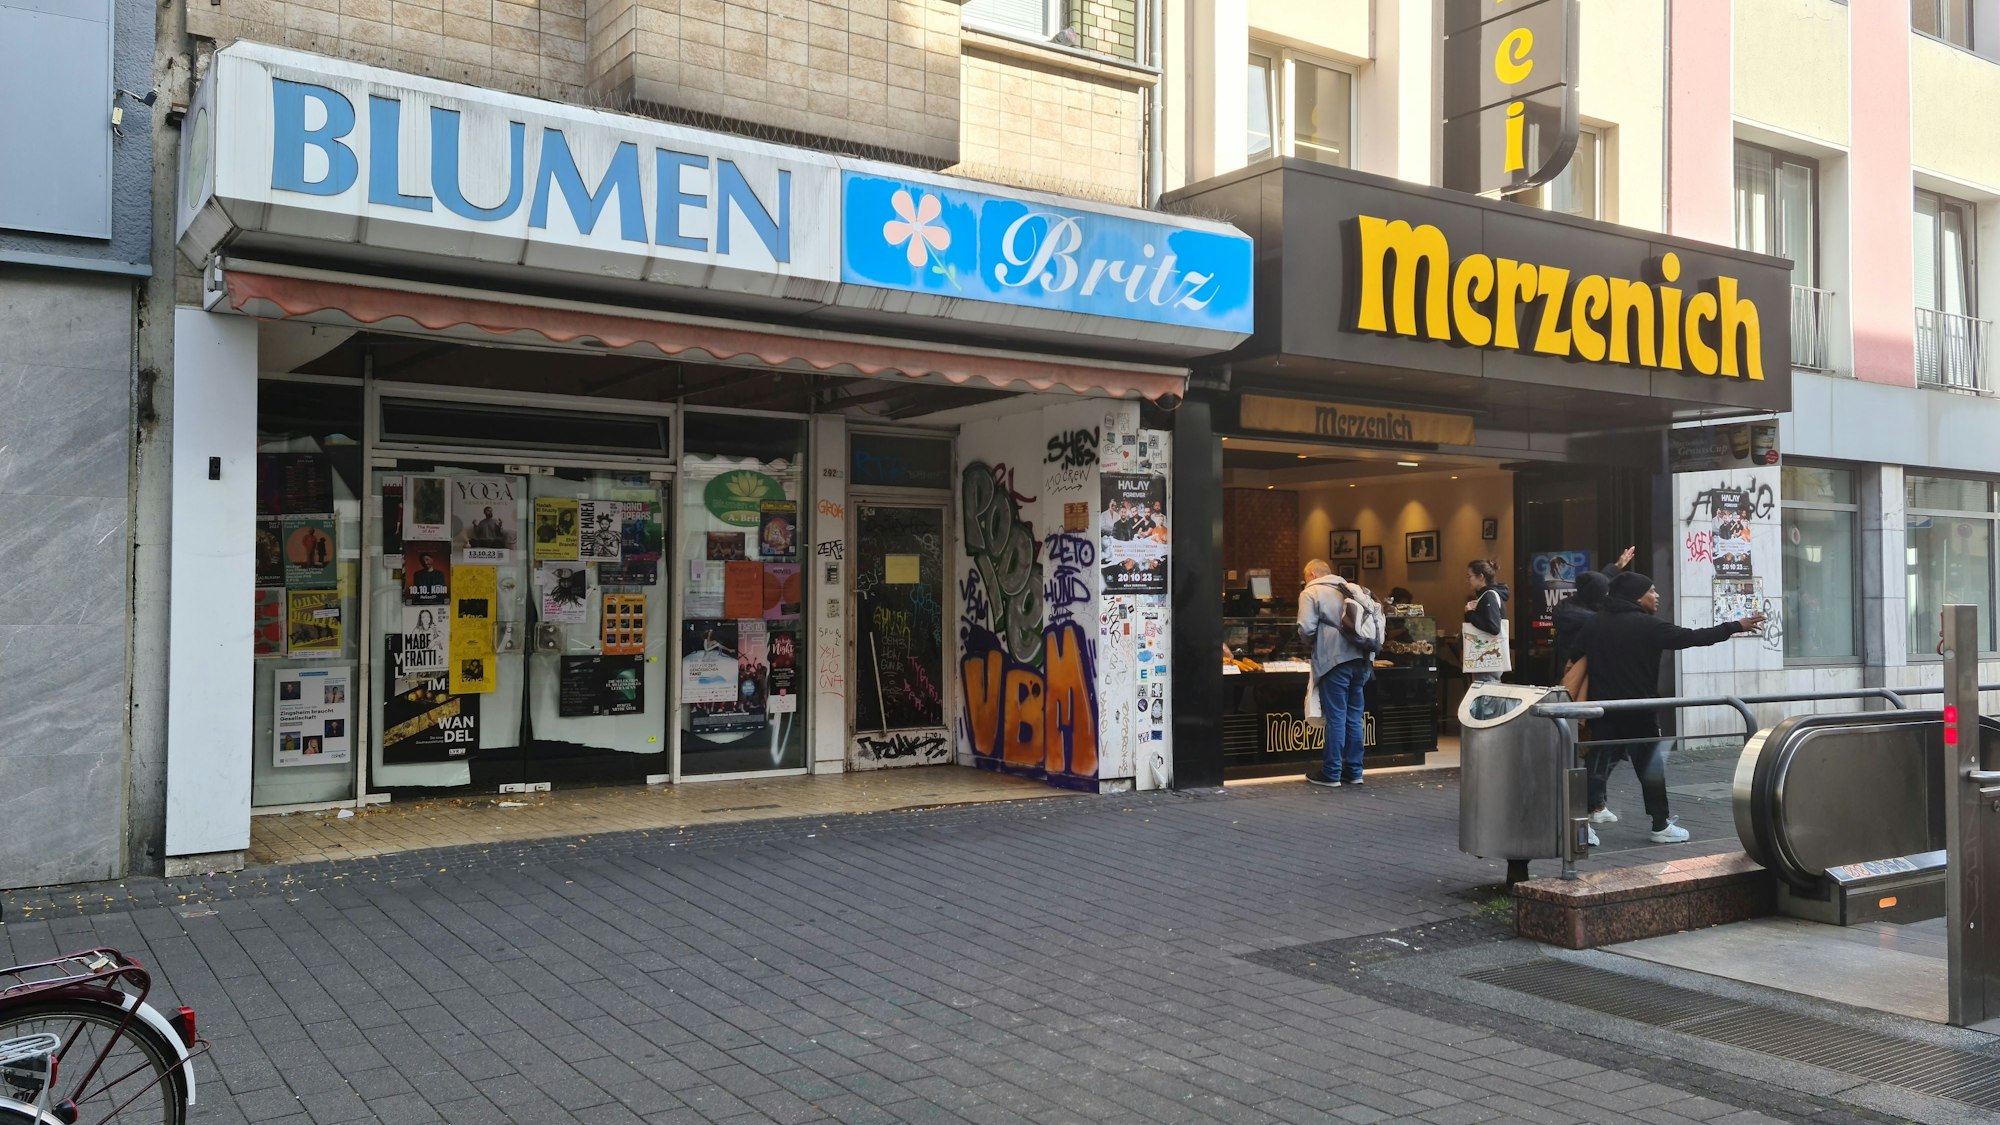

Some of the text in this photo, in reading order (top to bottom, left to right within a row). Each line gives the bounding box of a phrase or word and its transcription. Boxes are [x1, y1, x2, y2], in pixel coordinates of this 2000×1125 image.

[1495, 0, 1533, 173] ei
[271, 77, 791, 263] BLUMEN
[994, 212, 1220, 311] Britz
[1357, 214, 1765, 381] Merzenich
[456, 481, 514, 501] YOGA
[1118, 479, 1150, 490] HALAY
[740, 514, 760, 522] Brit
[408, 584, 448, 595] 10.10. Köln
[405, 633, 431, 650] MABE
[405, 650, 436, 666] FRATTI
[428, 678, 446, 690] IM
[438, 716, 474, 729] WAN
[444, 730, 474, 743] DEL
[1266, 712, 1377, 752] Merzh
